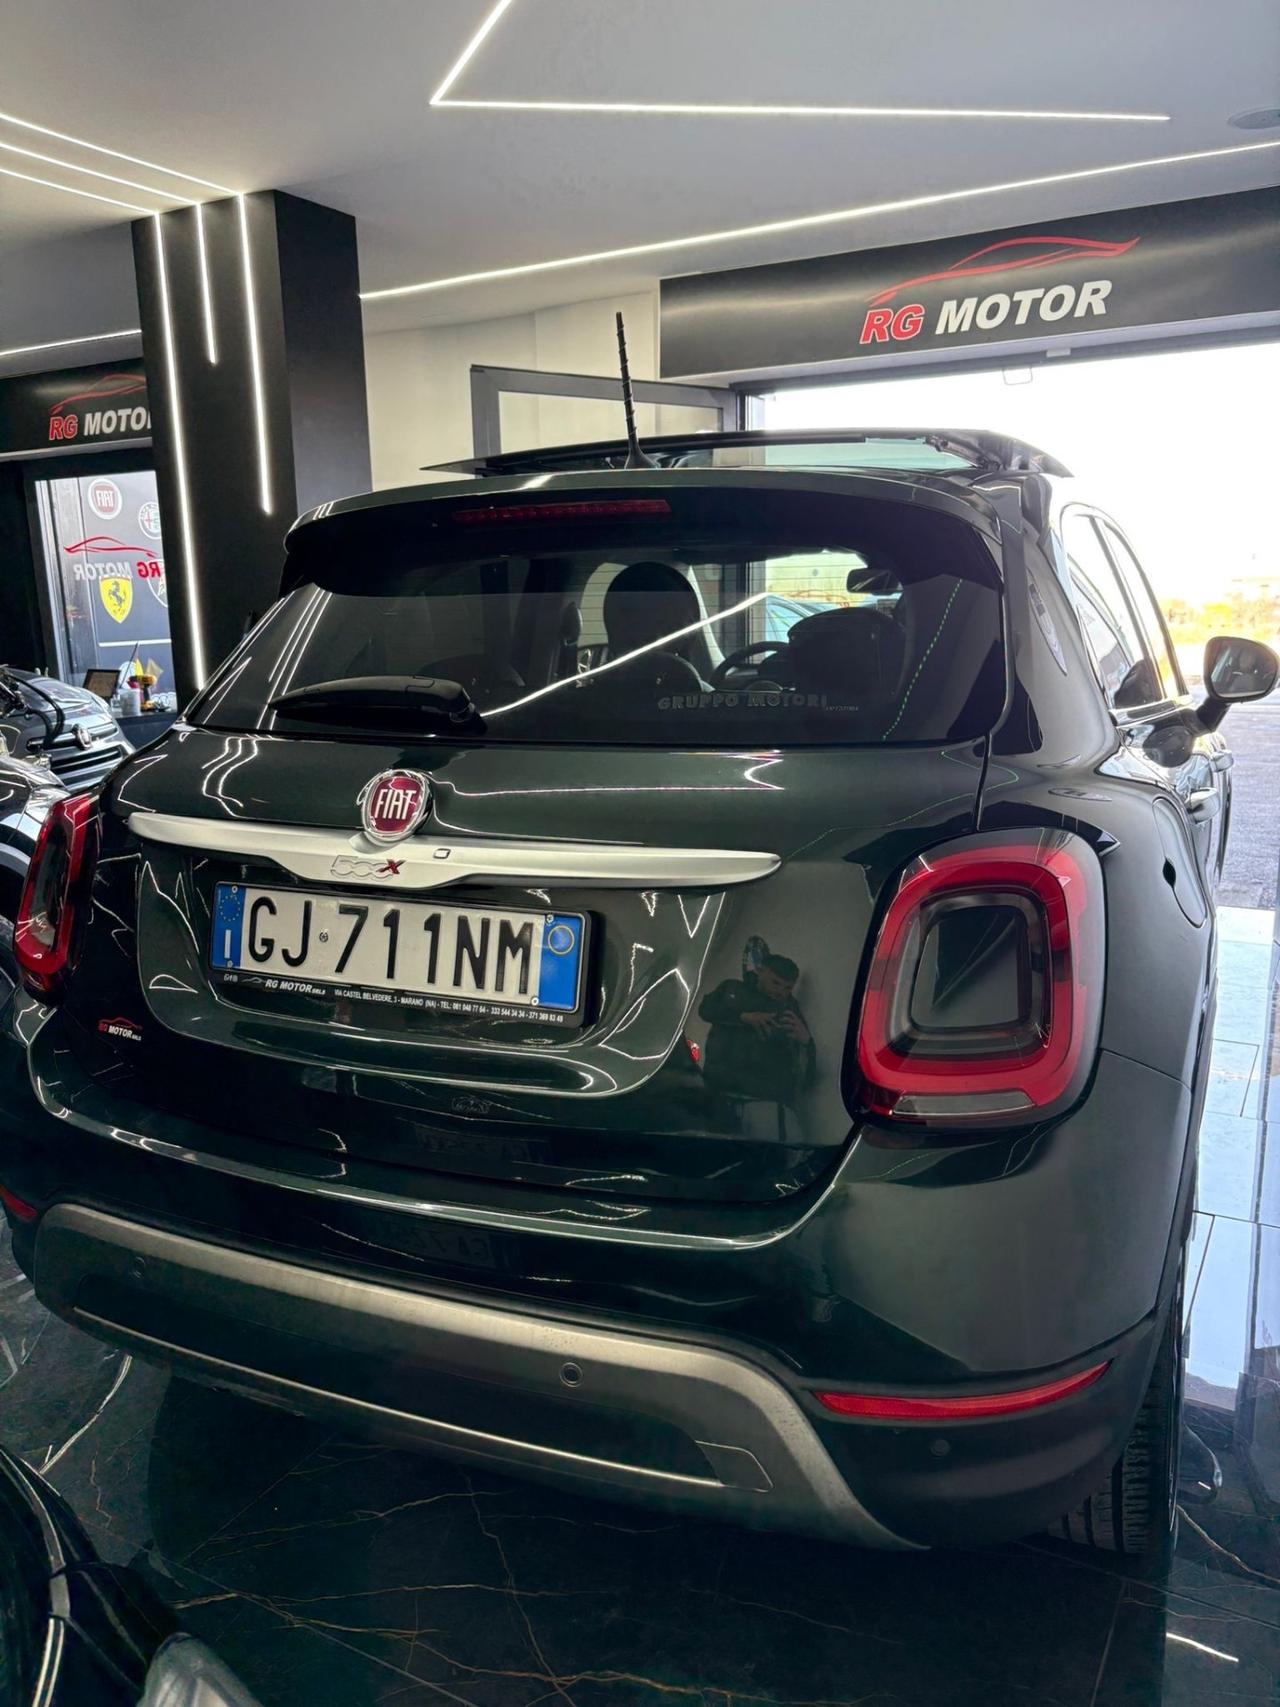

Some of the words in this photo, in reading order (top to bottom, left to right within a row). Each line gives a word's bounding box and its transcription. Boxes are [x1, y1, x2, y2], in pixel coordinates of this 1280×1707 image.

[859, 304, 926, 345] RG
[935, 279, 1113, 335] MOTOR
[49, 414, 79, 440] RG
[83, 406, 151, 436] MOTO
[96, 490, 114, 508] FIAT
[657, 694, 739, 710] GRUPPO
[747, 693, 827, 708] MOTORI
[374, 789, 417, 820] FIAT
[248, 896, 312, 967] GJ
[265, 979, 279, 989] RG
[280, 982, 312, 993] MOTOR
[343, 990, 361, 999] CASTEL
[400, 998, 423, 1006] MARANO
[108, 1025, 133, 1038] MOTOR
